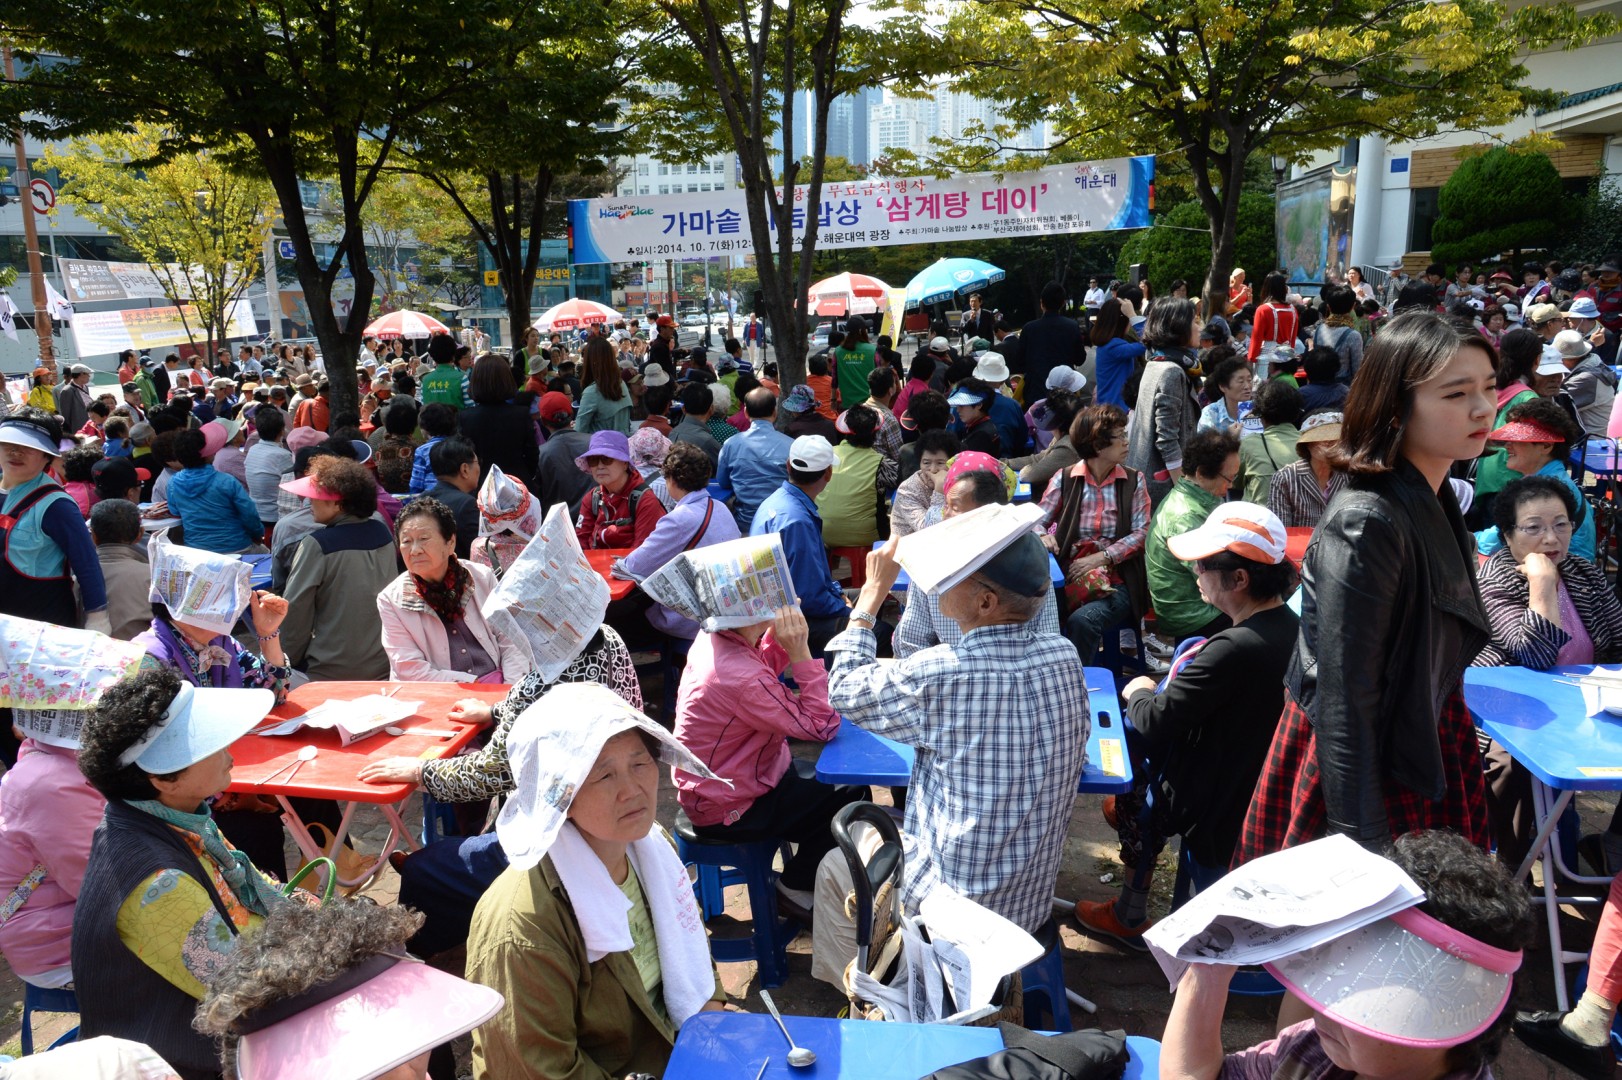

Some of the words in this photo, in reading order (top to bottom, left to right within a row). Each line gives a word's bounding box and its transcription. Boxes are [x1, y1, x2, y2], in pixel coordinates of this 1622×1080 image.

[827, 178, 926, 198] 무료급식행사
[1074, 173, 1117, 190] 해운대
[599, 206, 655, 220] Haeundae
[607, 204, 636, 212] Sun&Fun
[662, 208, 742, 237] 가마솥
[869, 229, 891, 242] 광장
[690, 242, 706, 252] 10.
[535, 268, 571, 280] 해운대역
